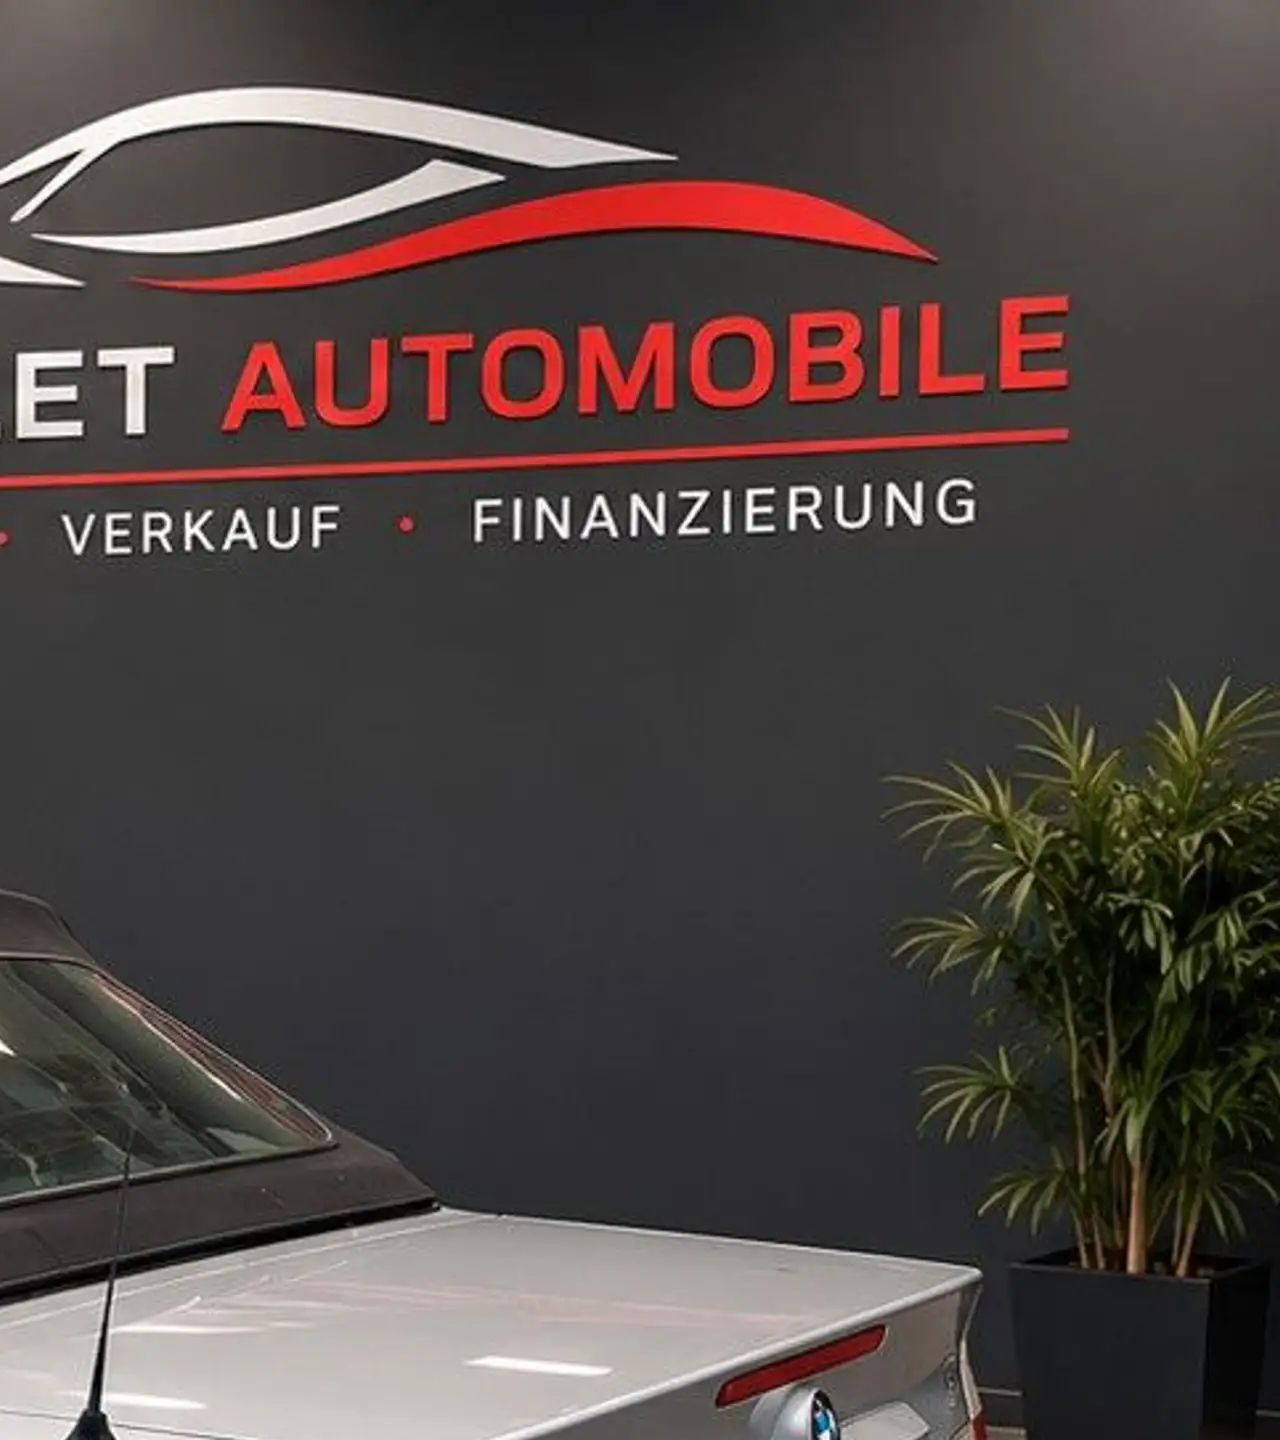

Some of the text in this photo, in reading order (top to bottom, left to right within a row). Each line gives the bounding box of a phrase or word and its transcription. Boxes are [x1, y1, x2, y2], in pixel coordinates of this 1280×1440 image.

[221, 295, 1070, 433] AUTOMOBILE
[61, 504, 340, 556] VERKAUF
[474, 478, 978, 543] FINANZIERUNG
